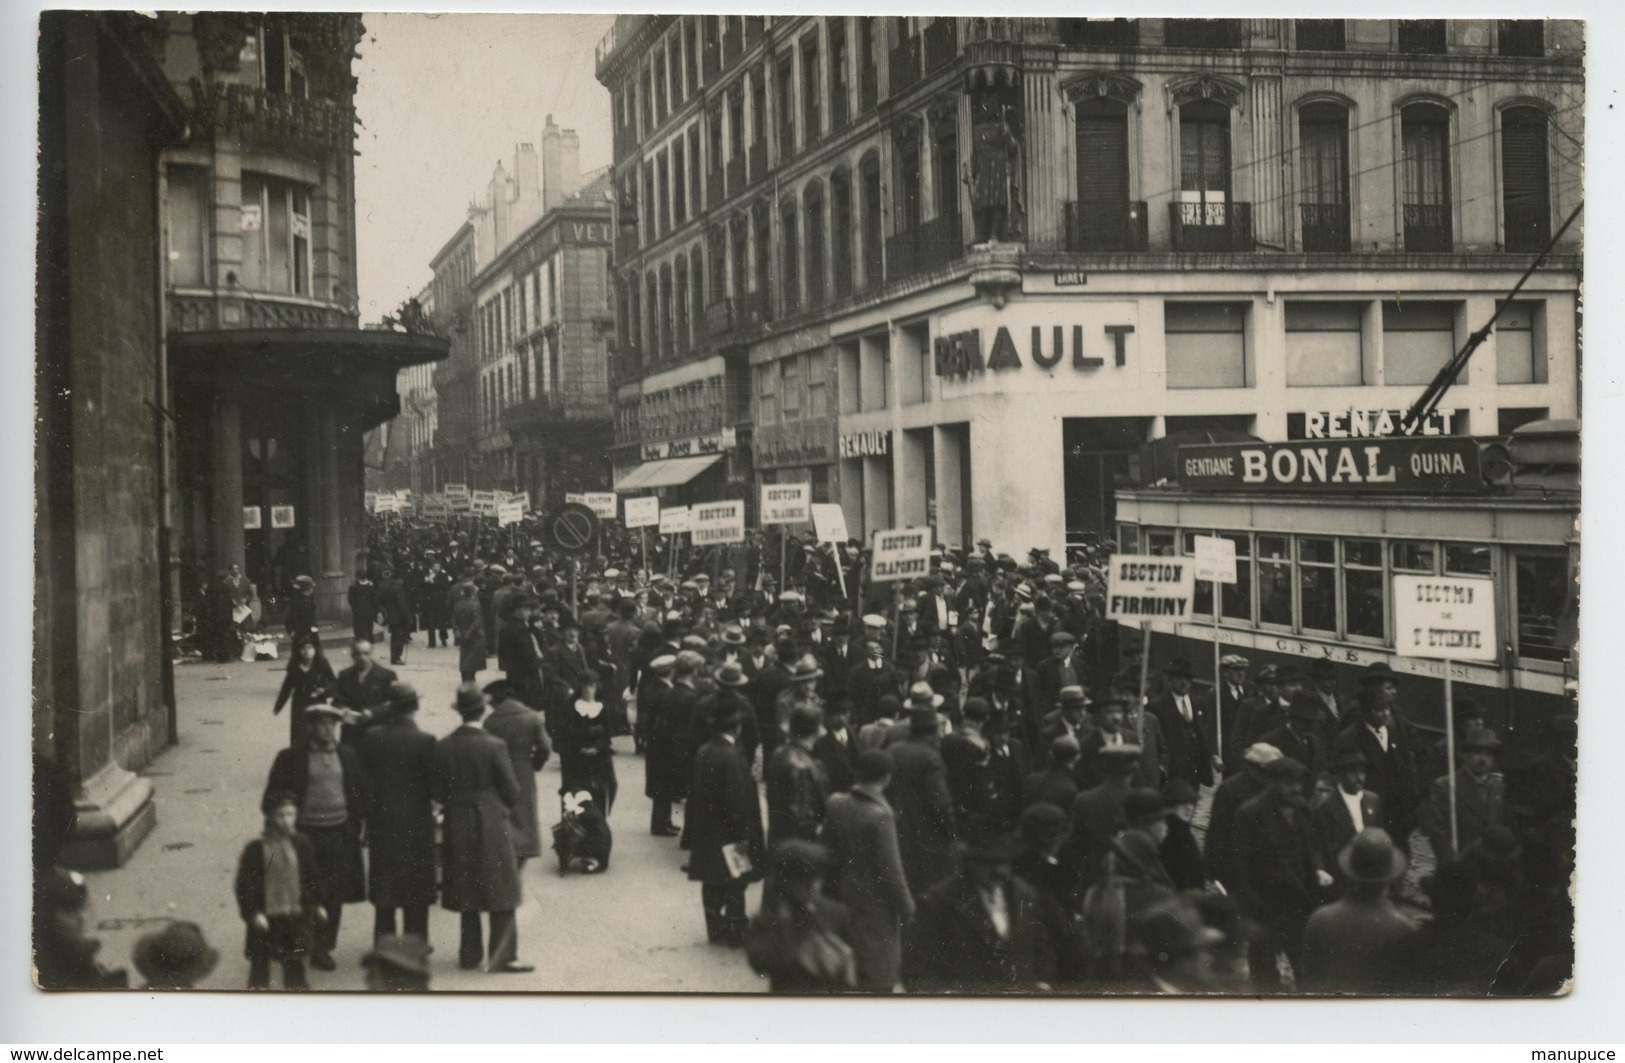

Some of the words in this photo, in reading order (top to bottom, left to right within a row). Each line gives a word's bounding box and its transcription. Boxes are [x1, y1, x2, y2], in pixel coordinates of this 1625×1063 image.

[934, 324, 1134, 379] RENAULT
[839, 432, 888, 458] RENAULT
[1185, 458, 1234, 477] GENTIANE
[1241, 446, 1396, 483] BONAL
[1410, 453, 1465, 478] QUINA
[699, 507, 736, 520] SECTION
[881, 534, 923, 551] SECTION
[876, 558, 925, 576] CRAPONNE
[1120, 563, 1183, 582] SECTION
[1111, 595, 1187, 616] FIRMINY
